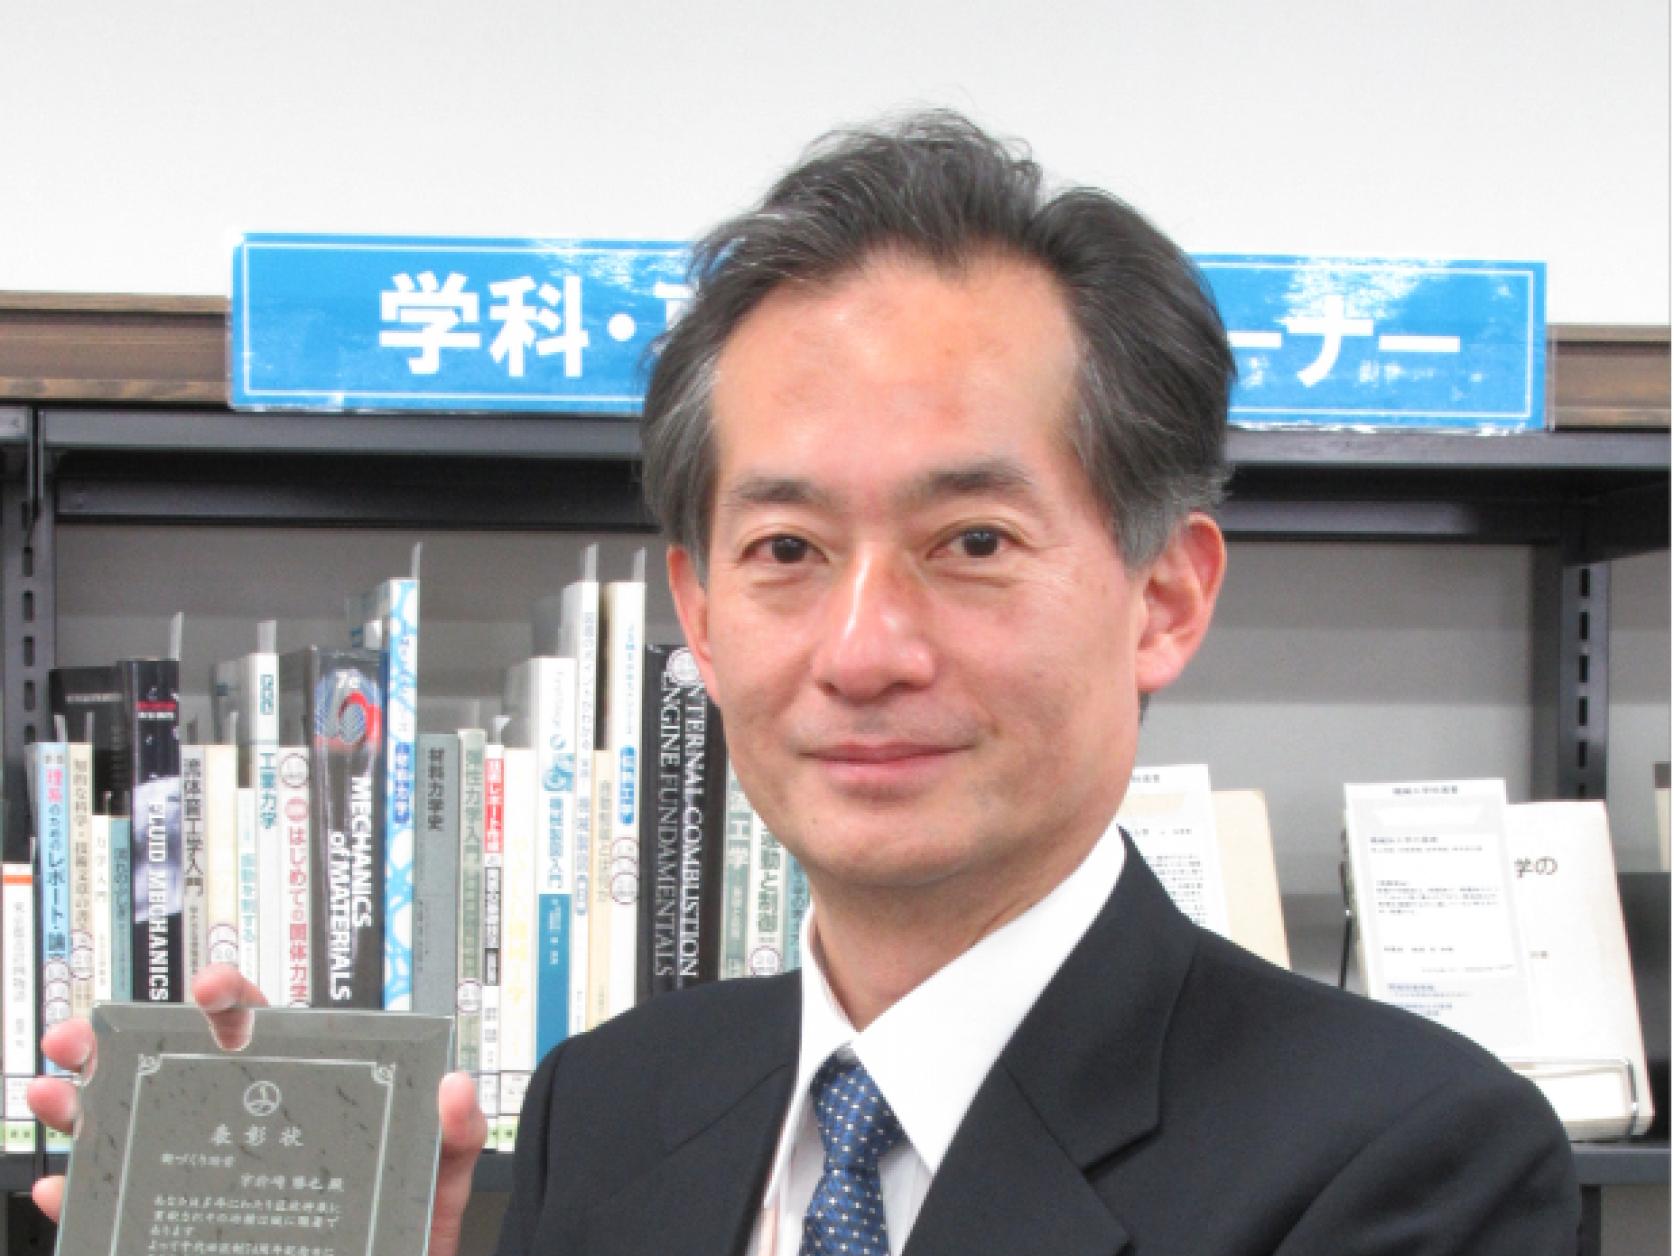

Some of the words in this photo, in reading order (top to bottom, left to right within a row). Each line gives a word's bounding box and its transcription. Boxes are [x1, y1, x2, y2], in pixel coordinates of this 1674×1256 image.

[379, 271, 692, 377] 学科・
[1227, 295, 1460, 387] ーナー
[684, 684, 707, 797] NTERNAL
[45, 768, 66, 958] 理系のためのレポート・論
[149, 801, 166, 862] FLUID
[330, 830, 345, 856] of
[351, 777, 372, 927] MECHANICS
[655, 773, 679, 977] FUNDAMENTALS
[680, 806, 704, 976] COMBUSTION
[1514, 856, 1558, 878] 学の
[149, 870, 168, 1000] MECHANICS
[330, 861, 351, 1000] MATERIALS
[210, 1124, 304, 1147] 表彰状
